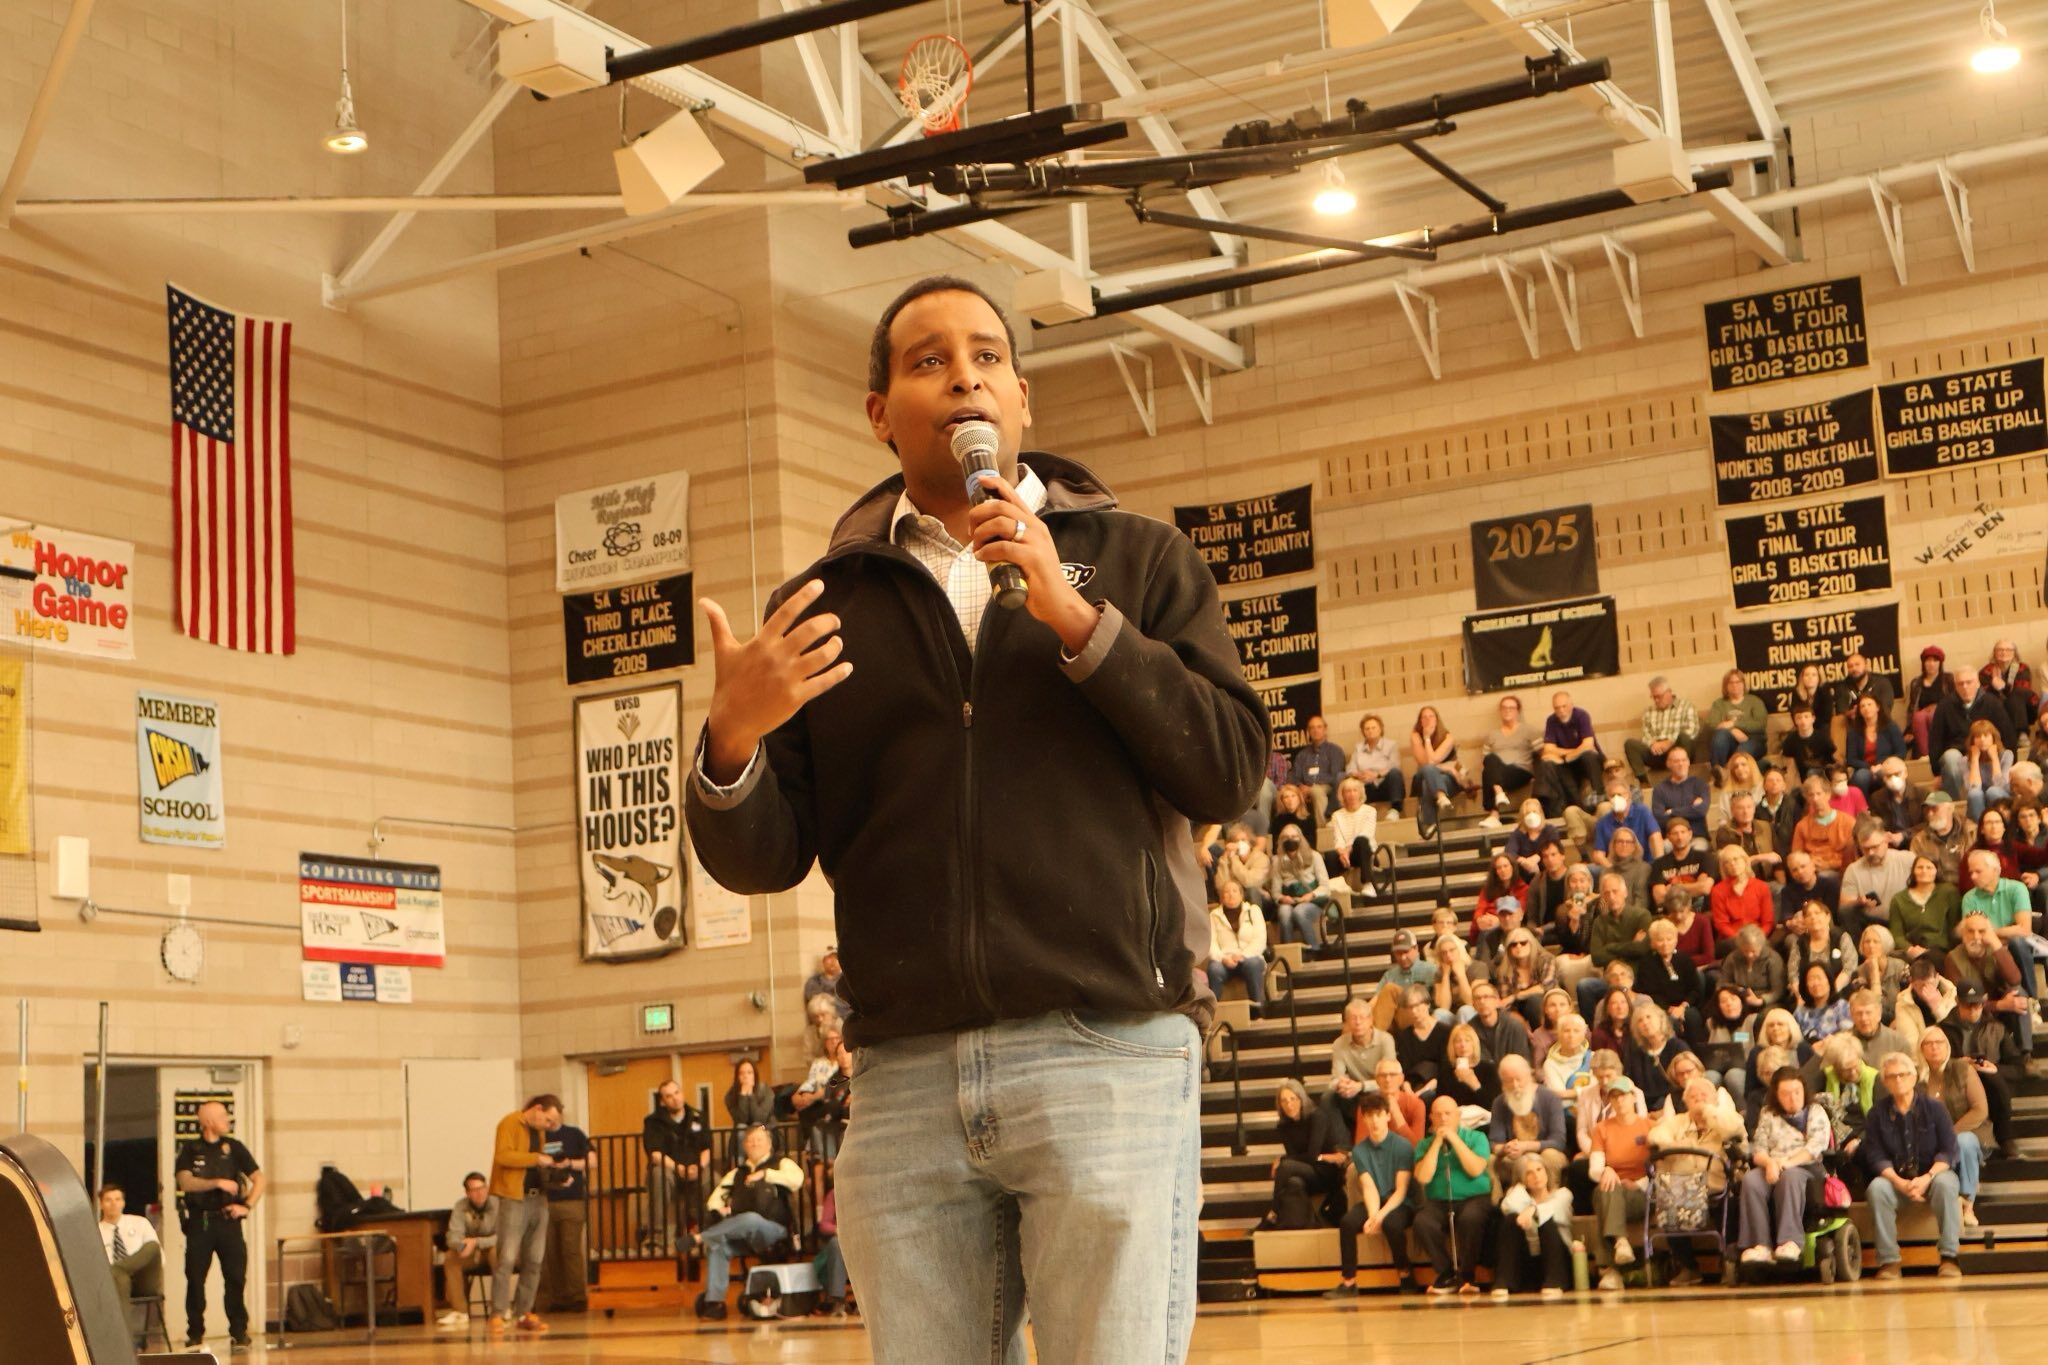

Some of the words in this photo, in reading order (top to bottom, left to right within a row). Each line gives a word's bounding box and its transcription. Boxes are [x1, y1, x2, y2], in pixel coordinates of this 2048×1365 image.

[1732, 300, 1759, 321] 5A
[1772, 285, 1833, 313] STATE
[1720, 318, 1780, 344] FINAL
[1793, 304, 1848, 331] FOUR
[1711, 343, 1753, 367] GIRLS
[1767, 324, 1865, 357] BASKETBALL
[1731, 347, 1848, 385] 2002-2003
[1905, 384, 1934, 403] 6A
[1947, 370, 2013, 396] STATE
[1750, 414, 1771, 431] 5A
[1784, 402, 1833, 426] STATE
[1900, 399, 1986, 425] RUNNER
[1995, 389, 2024, 409] UP
[1745, 421, 1840, 454] RUNNER-UP
[1887, 422, 1934, 448] GIRLS
[1938, 408, 2043, 441] BASKETBALL
[1717, 456, 1773, 481] WOMENS
[1784, 438, 1874, 472] BASKETBALL
[1937, 439, 1995, 464] 2023
[1751, 468, 1845, 500] 2008-2009
[1208, 506, 1226, 522] 5A
[1237, 496, 1278, 517] STATE
[1765, 513, 1785, 533] 5A
[1797, 503, 1845, 528] STATE
[653, 529, 683, 547] 08-09
[1191, 522, 1243, 544] FOURTH
[1253, 511, 1296, 535] PLACE
[1488, 514, 1579, 561] 2025
[1758, 534, 1803, 558] FINAL
[1815, 526, 1857, 550] FOUR
[1943, 537, 1973, 563] THE
[1974, 511, 2005, 539] DEN
[568, 548, 597, 565] Cheer
[1238, 530, 1310, 559] X-COUNTRY
[34, 540, 128, 590] Honor
[1229, 561, 1263, 582] 2010
[1732, 560, 1777, 585] GIRLS
[1789, 546, 1889, 576] BASKETBALL
[65, 576, 91, 598] the
[594, 592, 611, 609] 5A
[620, 581, 660, 605] STATE
[1769, 573, 1856, 603] 2009-2010
[33, 582, 128, 630] Game
[584, 611, 621, 633] THIRD
[631, 602, 673, 626] PLACE
[1222, 602, 1232, 618] A
[1242, 594, 1283, 616] STATE
[14, 608, 68, 642] Here
[1228, 614, 1289, 639] NNER-UP
[1772, 621, 1794, 641] 5A
[1806, 612, 1857, 637] STATE
[583, 625, 676, 658] CHEERLEADING
[1245, 632, 1317, 659] X-COUNTRY
[1768, 635, 1864, 666] RUNNER-UP
[613, 654, 648, 675] 2009
[138, 697, 216, 727] MEMBER
[614, 696, 640, 712] BVSD
[1270, 708, 1296, 728] OUR
[586, 744, 622, 773] WHO
[628, 737, 673, 769] PLAYS
[589, 774, 611, 812] IN
[618, 766, 670, 807] THIS
[143, 797, 218, 821] SCHOOL
[586, 804, 675, 851] HOUSE?
[301, 863, 394, 885] COMPETING
[302, 884, 395, 907] SPORTSMANSHIP
